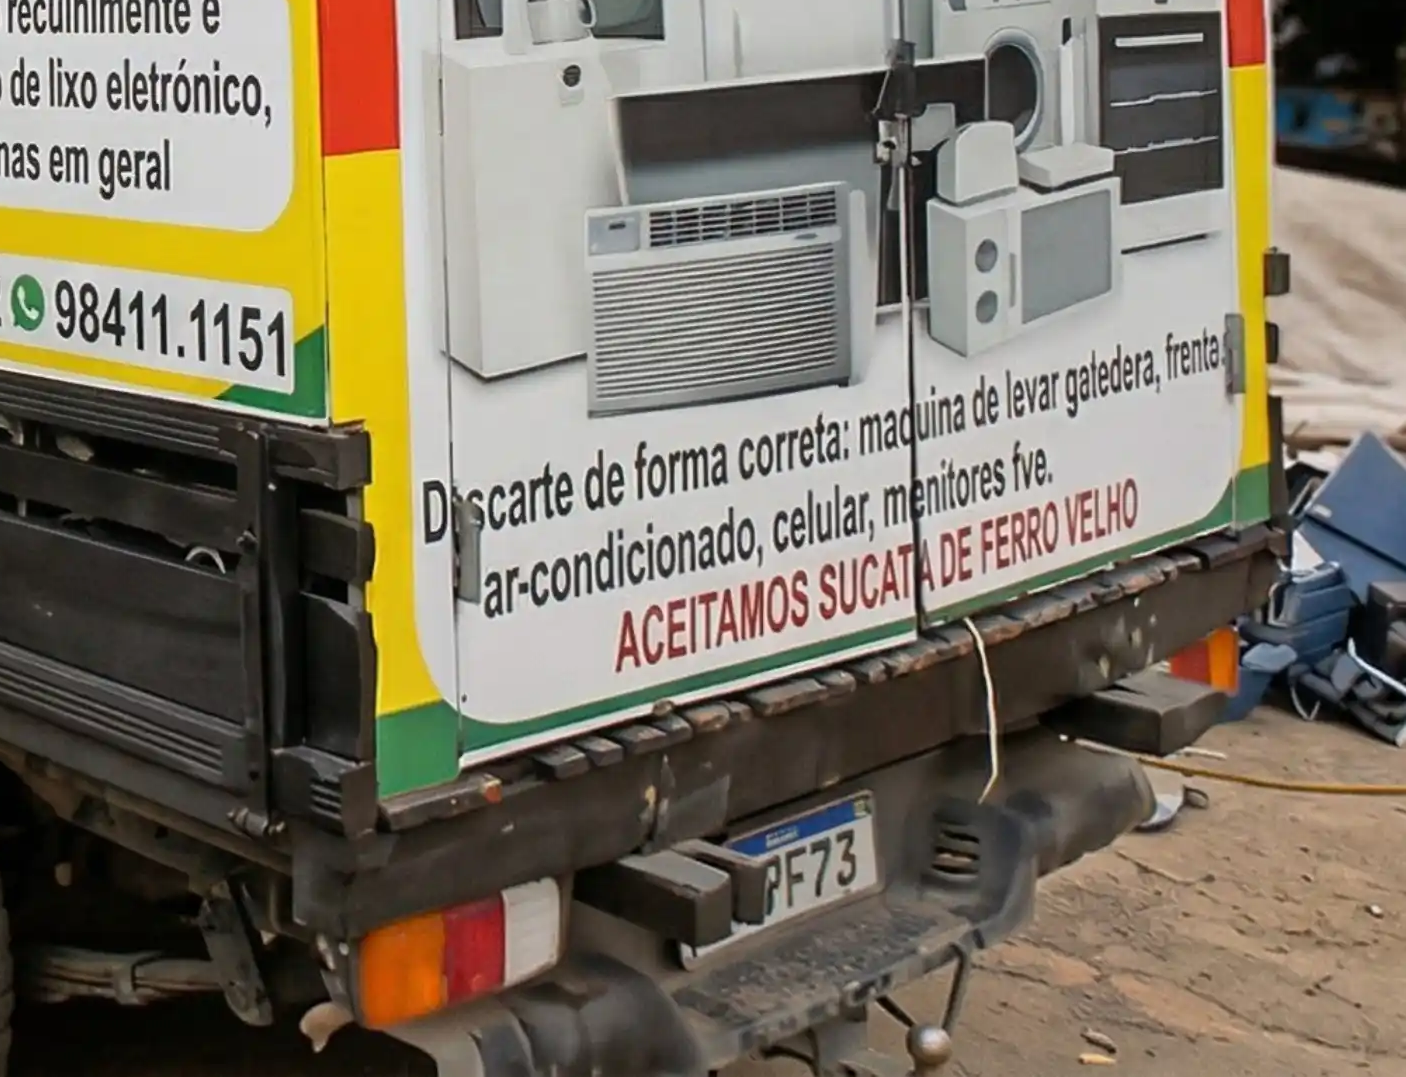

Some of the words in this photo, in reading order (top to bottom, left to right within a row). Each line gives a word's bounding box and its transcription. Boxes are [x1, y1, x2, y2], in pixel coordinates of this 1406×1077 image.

[10, 57, 41, 107] de
[49, 56, 98, 109] lixo
[49, 144, 90, 184] em
[98, 139, 171, 200] geral
[54, 279, 287, 377] 98411.1151
[584, 450, 625, 508] de
[634, 441, 729, 501] forma
[738, 412, 849, 480] correta:
[972, 375, 1000, 427] de
[1005, 370, 1059, 419] levar
[483, 507, 763, 619] ar-condicionado,
[772, 484, 875, 552] celular,
[614, 570, 808, 673] ACEITAMOS
[818, 538, 935, 620] SUCATA
[940, 525, 973, 587] DE
[981, 501, 1059, 574] FERRO
[1065, 478, 1138, 547] VELHO
